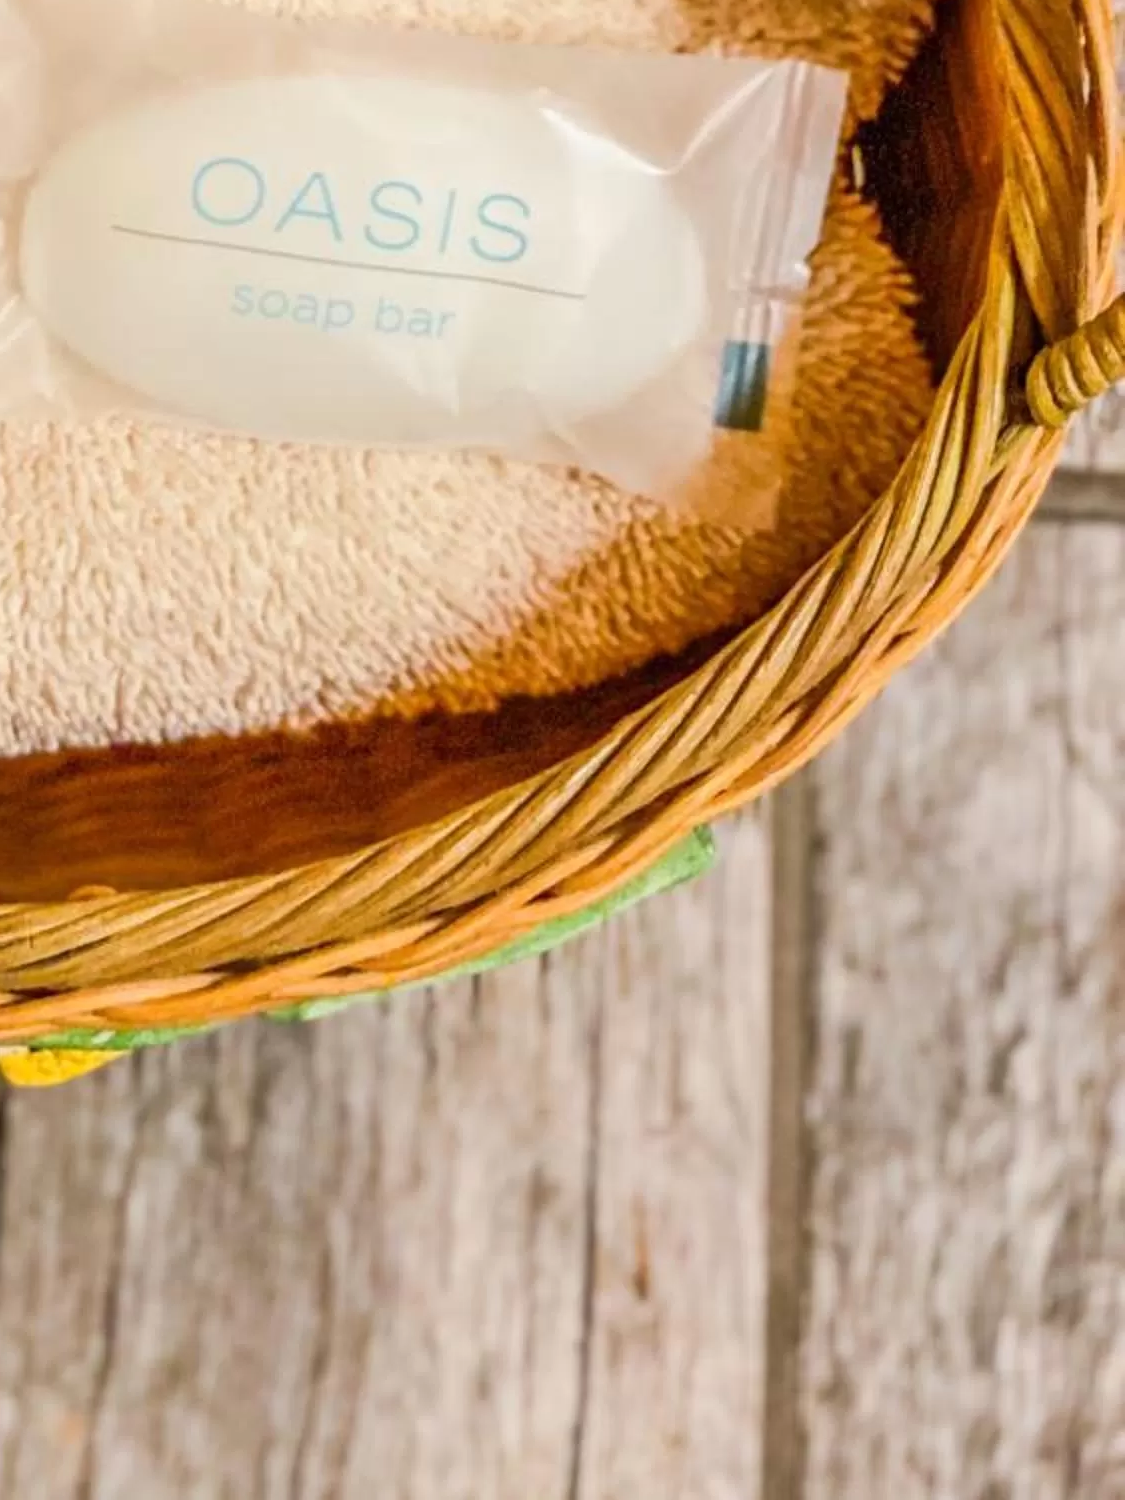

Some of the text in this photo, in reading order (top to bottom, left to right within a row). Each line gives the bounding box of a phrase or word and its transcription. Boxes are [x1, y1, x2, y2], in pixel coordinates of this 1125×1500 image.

[190, 157, 532, 263] OASIS
[229, 282, 457, 340] soap bar
